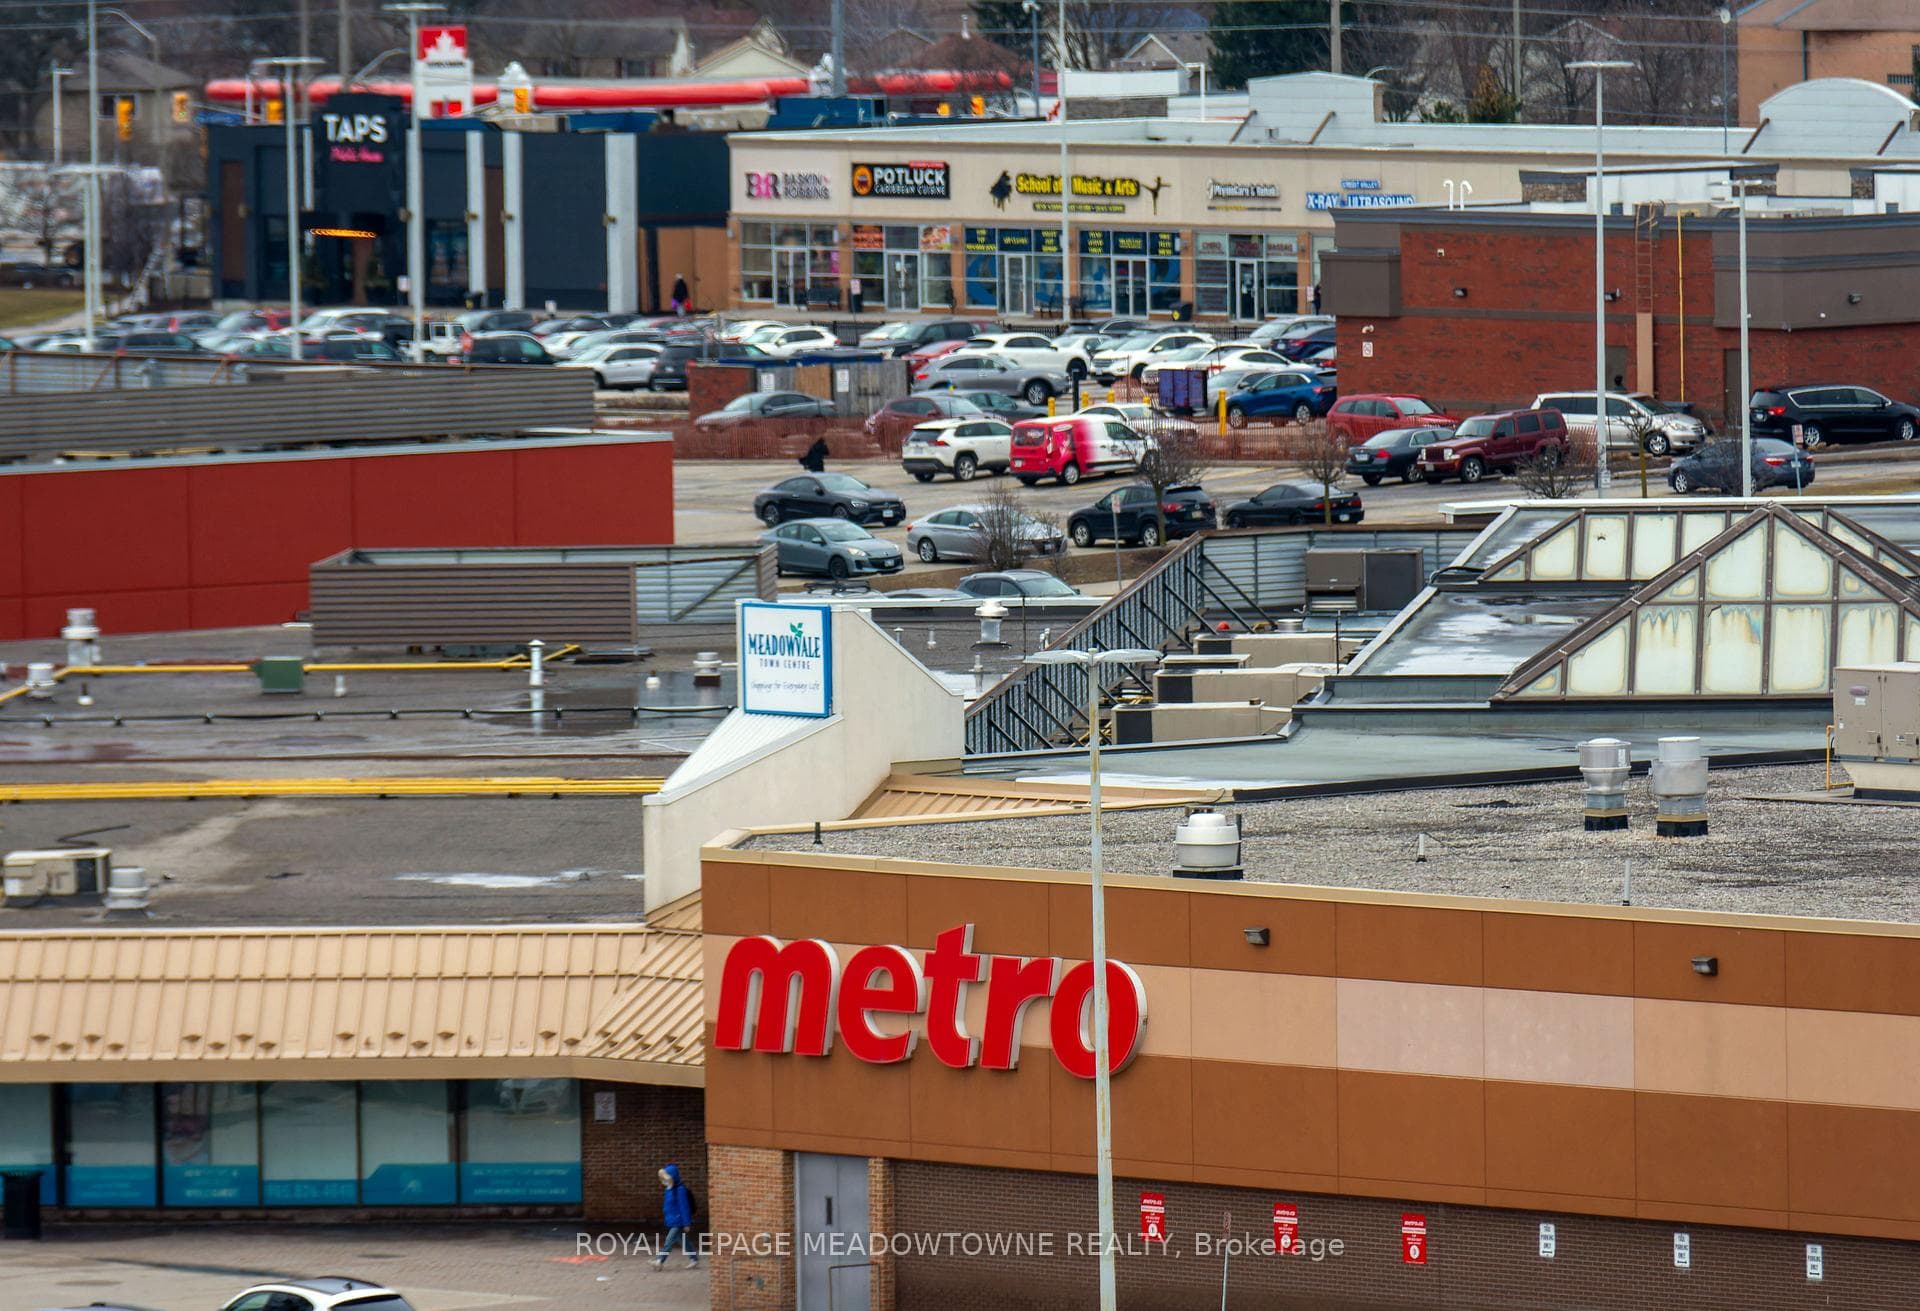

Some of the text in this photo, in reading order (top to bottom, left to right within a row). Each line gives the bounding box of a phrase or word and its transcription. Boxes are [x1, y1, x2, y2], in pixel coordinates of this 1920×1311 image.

[322, 114, 388, 143] TAPS
[783, 173, 823, 185] BASKIN
[873, 167, 945, 185] POTLUCK
[874, 185, 946, 196] CARIBBEAN CUISINE
[1016, 174, 1051, 194] School
[1072, 176, 1103, 195] Music
[1115, 178, 1140, 197] Arts
[1307, 193, 1339, 209] X-RAY
[748, 633, 821, 659] MEADOWVALE
[760, 658, 811, 671] TOWN CENTRE
[715, 924, 1147, 1079] metro
